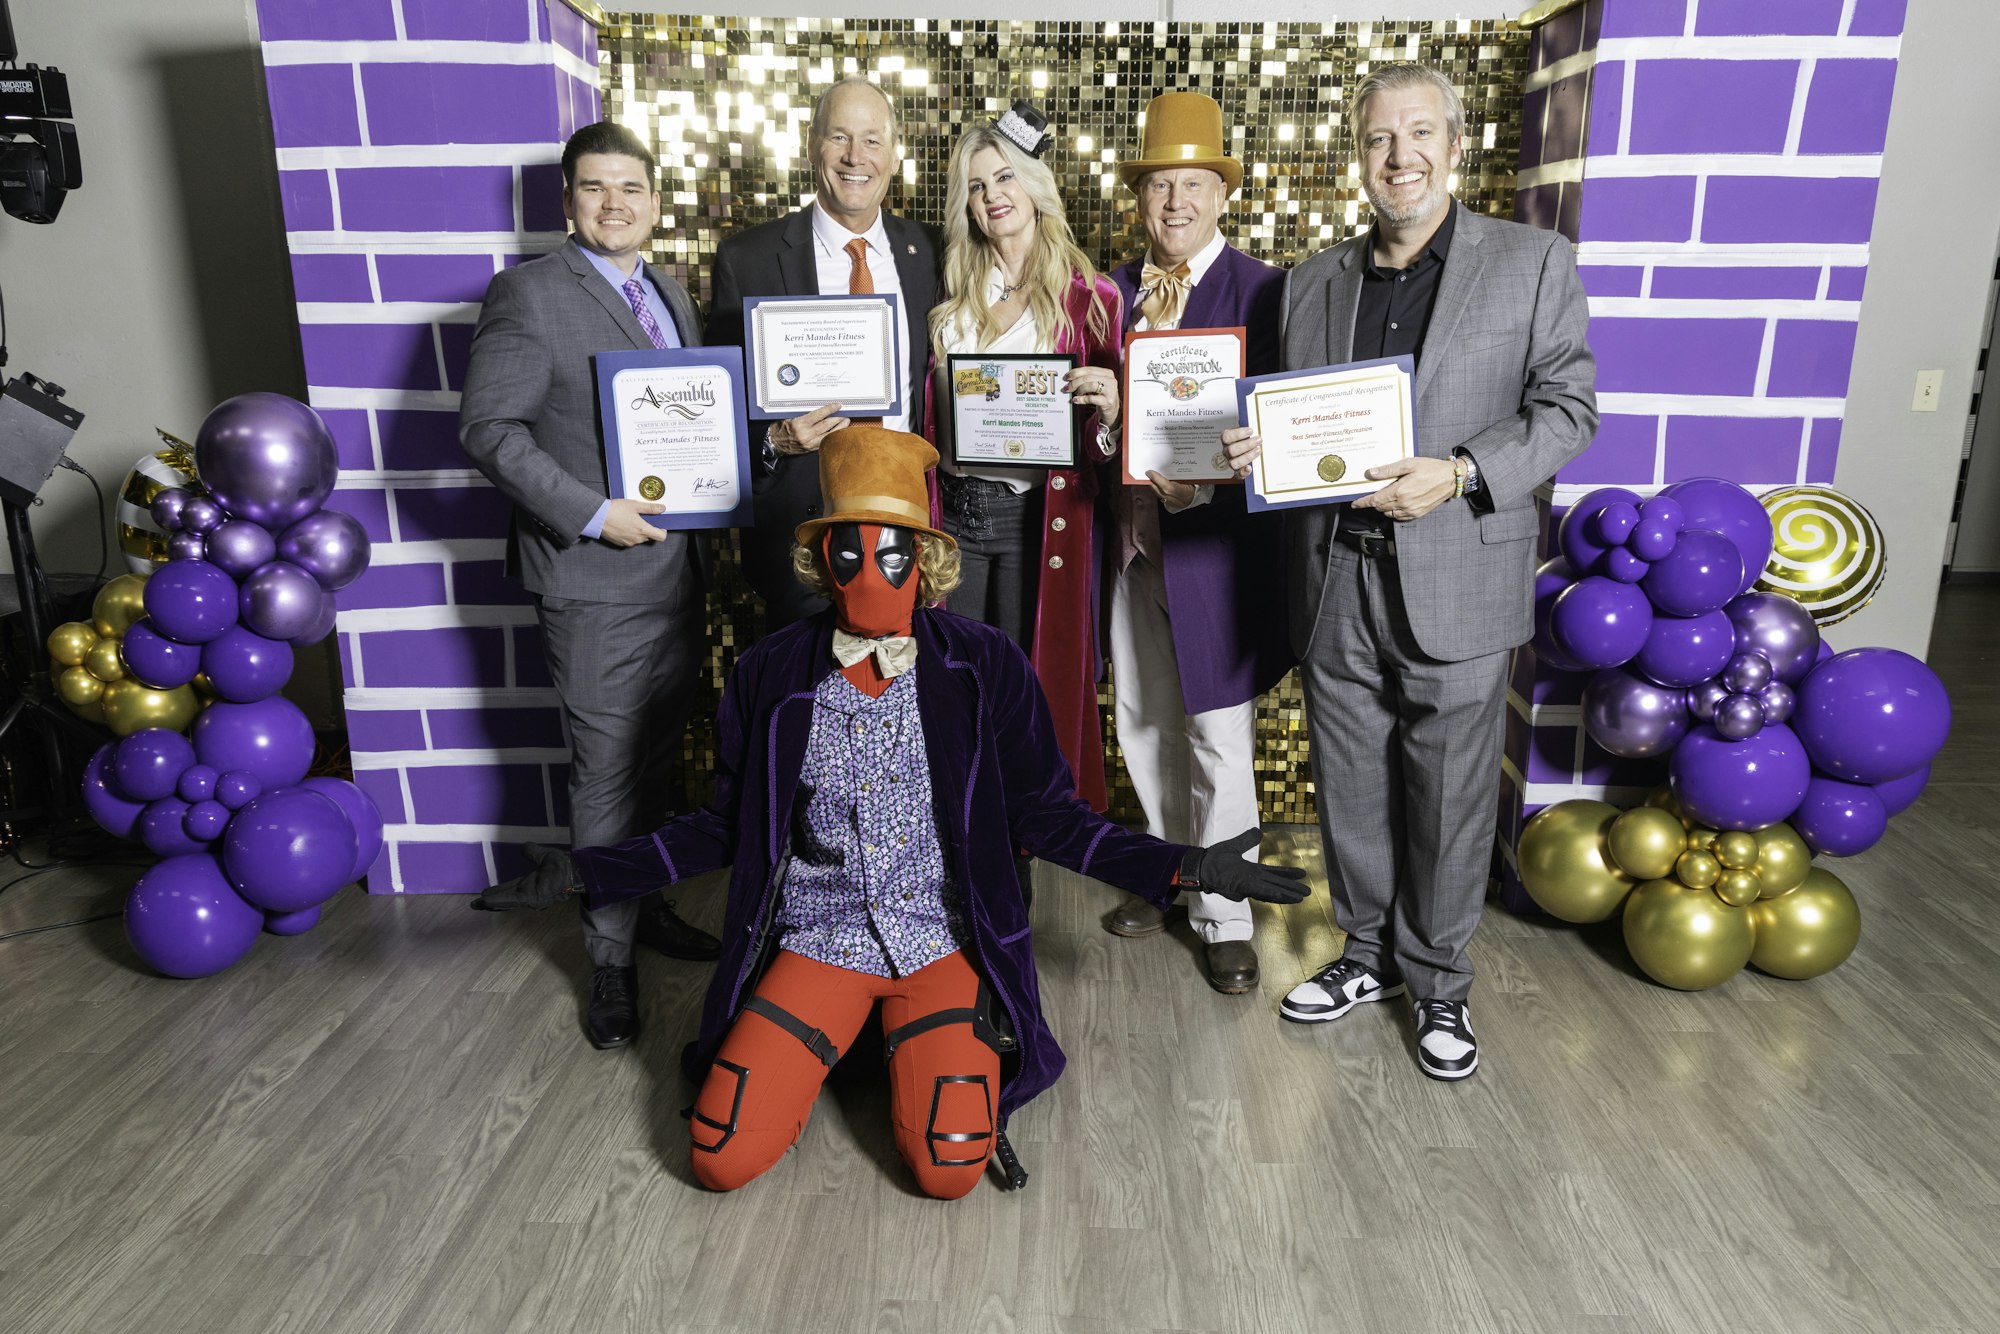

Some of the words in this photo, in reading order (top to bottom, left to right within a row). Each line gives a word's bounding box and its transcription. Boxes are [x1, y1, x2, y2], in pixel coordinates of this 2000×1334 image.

[784, 334, 804, 342] Kerri
[806, 333, 836, 341] Mandes
[838, 332, 865, 340] Fitness
[1160, 345, 1208, 359] certificate
[981, 364, 1001, 373] BEST
[1146, 358, 1222, 380] RECOGNITION
[960, 372, 973, 381] Best
[1014, 369, 1059, 395] BEST
[631, 380, 715, 411] Assembly
[1264, 396, 1299, 407] Certificate
[1300, 394, 1308, 404] of
[1308, 388, 1354, 402] Congressional
[1355, 383, 1394, 395] Recognition
[1146, 409, 1165, 417] Kerri
[1167, 408, 1196, 416] Mandes
[1198, 408, 1224, 416] Fitness
[1291, 415, 1311, 426] Kerri
[1312, 411, 1342, 423] Mandes
[1344, 408, 1372, 419] Fitness
[1021, 420, 1044, 428] Fitness
[659, 435, 691, 444] Mandes
[692, 435, 720, 443] Fitness
[1304, 431, 1322, 440] Senior
[1322, 425, 1373, 437] Fitness/Recreation
